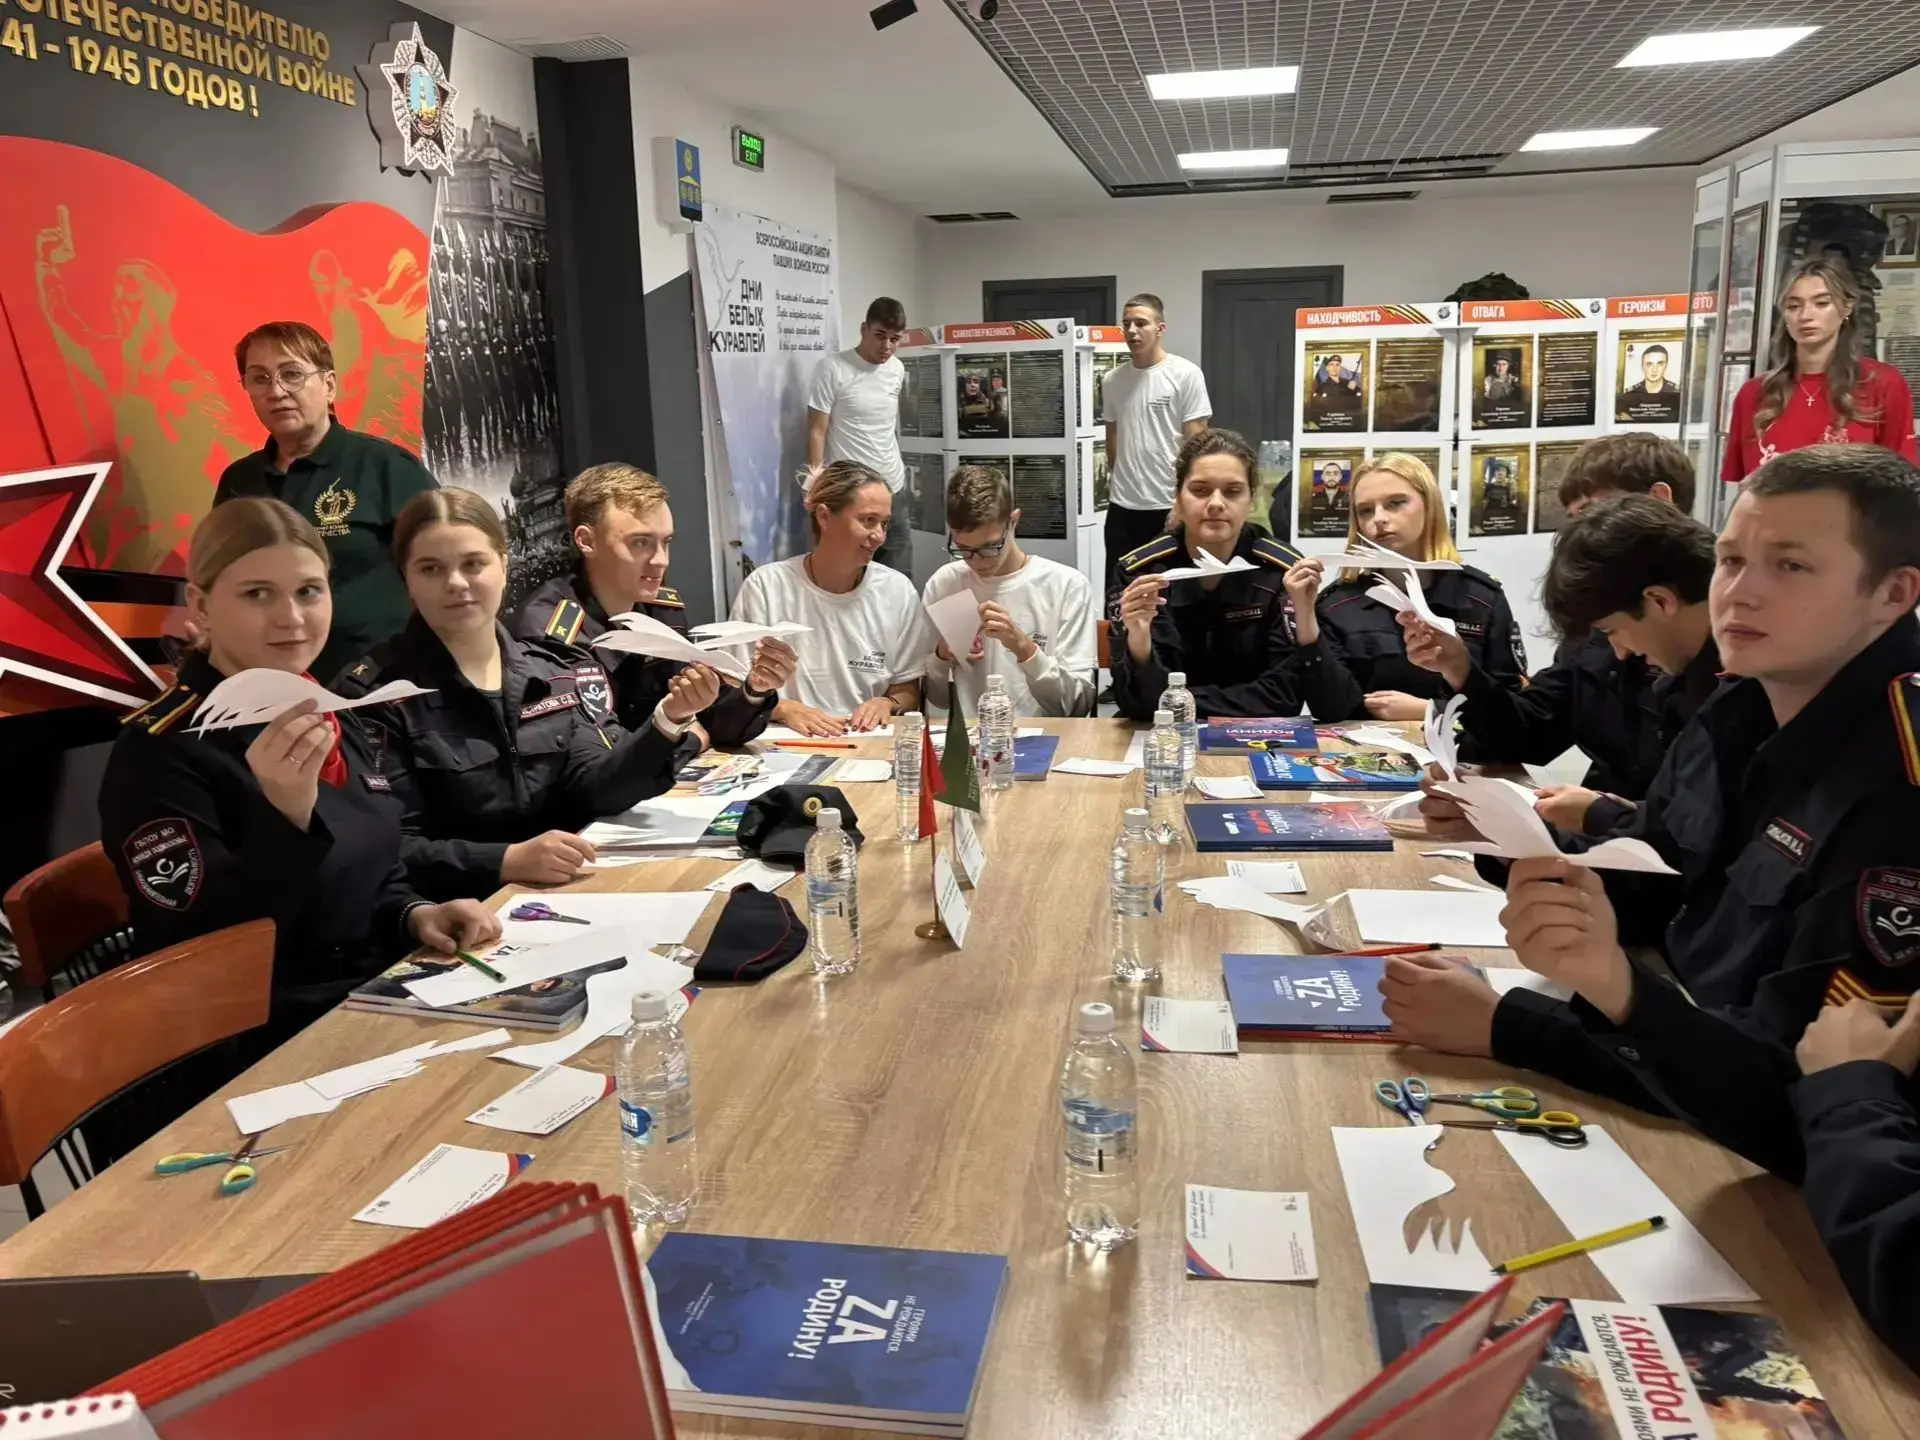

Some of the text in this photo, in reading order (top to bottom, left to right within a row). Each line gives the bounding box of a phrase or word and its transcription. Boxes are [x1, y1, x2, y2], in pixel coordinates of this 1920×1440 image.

[148, 0, 330, 63] БЕДИТЕЛЮ
[0, 17, 37, 60] 41
[66, 35, 141, 86] 1945
[277, 54, 357, 107] ВОЙНЕ
[745, 149, 758, 163] EXIT
[755, 231, 798, 253] ВСЕРОССИЙСКАЯ
[798, 241, 813, 256] АКЦИЯ
[741, 279, 763, 303] ДНИ
[728, 304, 765, 327] БЕЛЫХ
[1306, 310, 1381, 325] НАХОДЧИВОСТЬ
[1471, 305, 1505, 319] ОТВАГА
[1618, 299, 1666, 315] ГЕРОИЗМ
[1292, 976, 1337, 1000] ZA
[1329, 970, 1362, 1007] РОДИНУ!
[904, 1295, 916, 1306] НЕ
[787, 1278, 848, 1360] РОДИНУ!
[826, 1295, 899, 1344] ZA
[904, 1308, 926, 1343] ГЕРОЯМИ
[1591, 1312, 1629, 1387] РОЖДАЮТСЯ.
[1611, 1314, 1693, 1424] РОДИНУ!
[1620, 1387, 1640, 1402] НЕ
